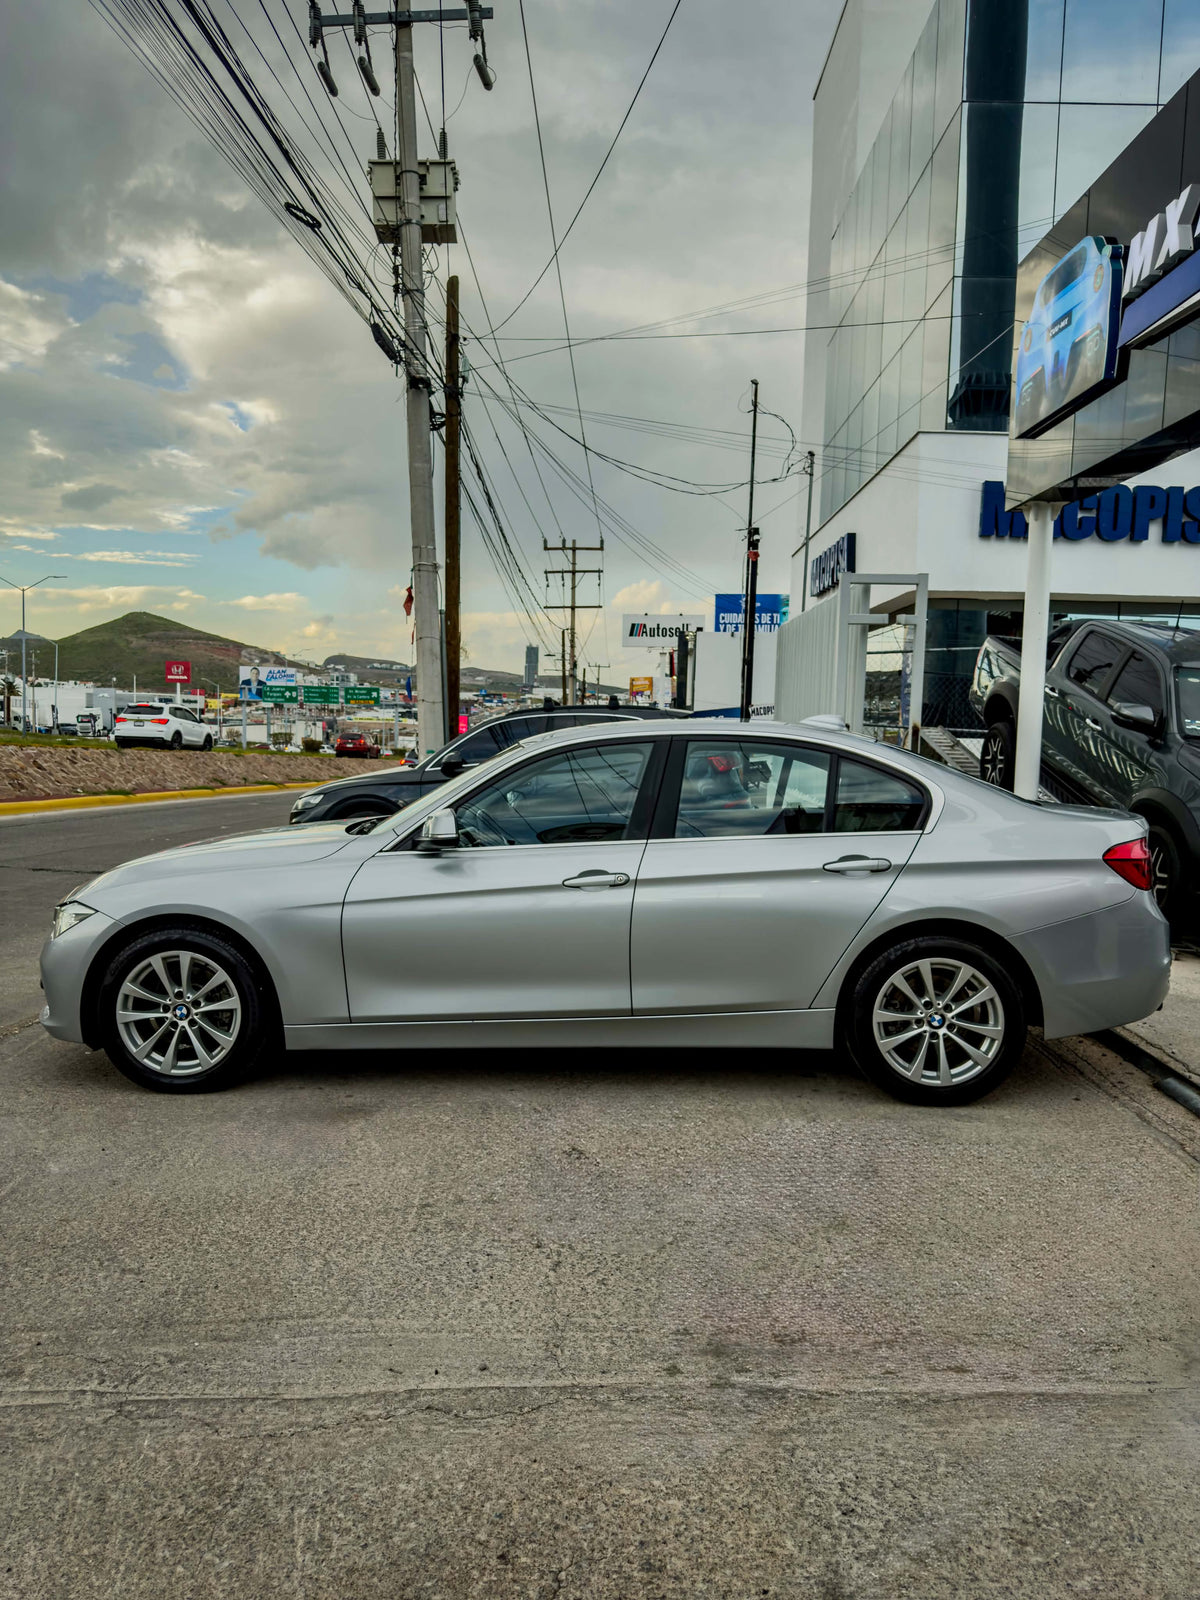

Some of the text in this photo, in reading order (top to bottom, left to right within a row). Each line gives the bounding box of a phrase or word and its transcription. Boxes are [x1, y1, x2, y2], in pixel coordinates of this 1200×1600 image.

[1121, 183, 1200, 298] MX
[719, 613, 780, 624] CUIDAS DE TI
